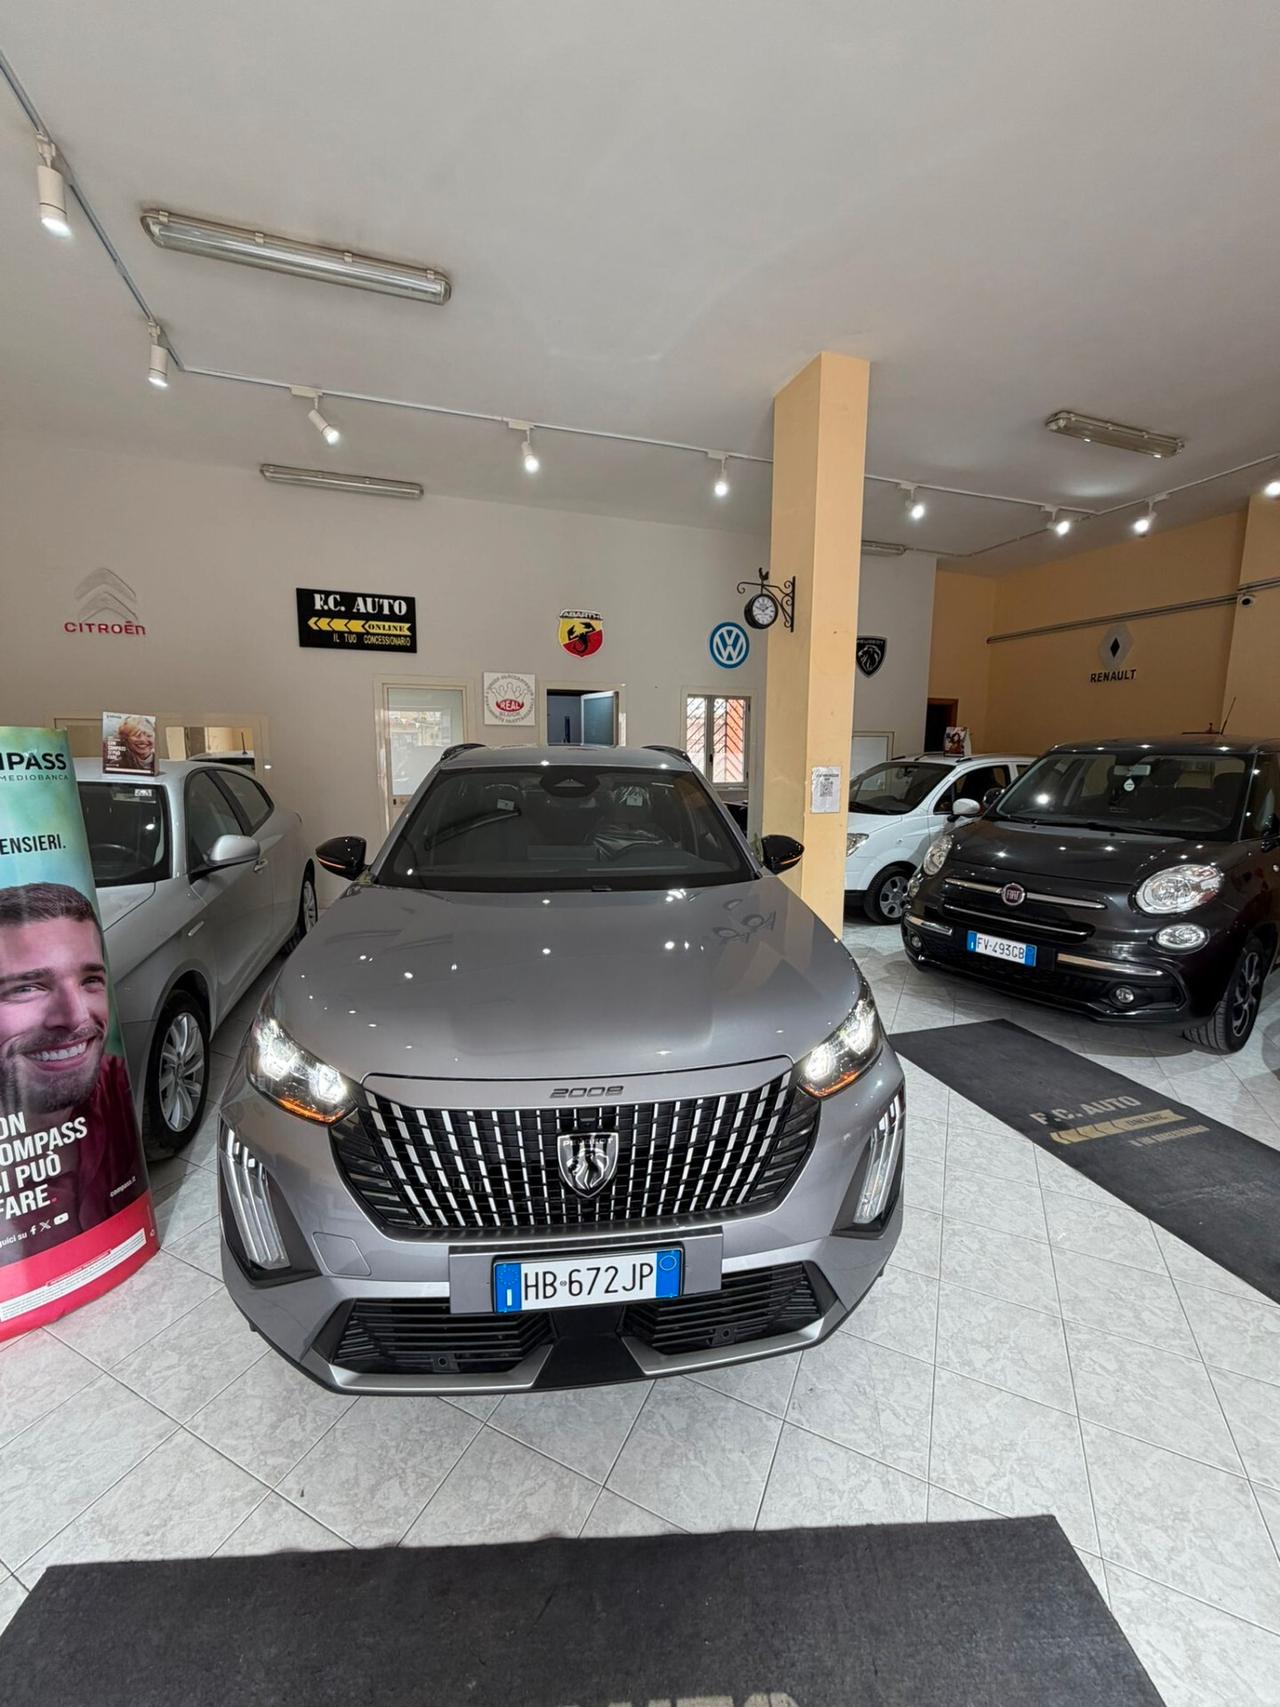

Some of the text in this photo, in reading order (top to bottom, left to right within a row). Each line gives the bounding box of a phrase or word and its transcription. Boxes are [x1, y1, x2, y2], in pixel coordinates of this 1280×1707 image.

[313, 593, 408, 616] F.C. AUTO
[367, 623, 406, 632] ONLINE
[1090, 669, 1137, 684] RENAULT
[500, 700, 522, 710] REAL
[0, 752, 67, 771] PASS
[550, 1085, 624, 1099] 2008
[1080, 1095, 1142, 1116] AUTO
[15, 1151, 62, 1189] PUÒ
[18, 1231, 28, 1241] su
